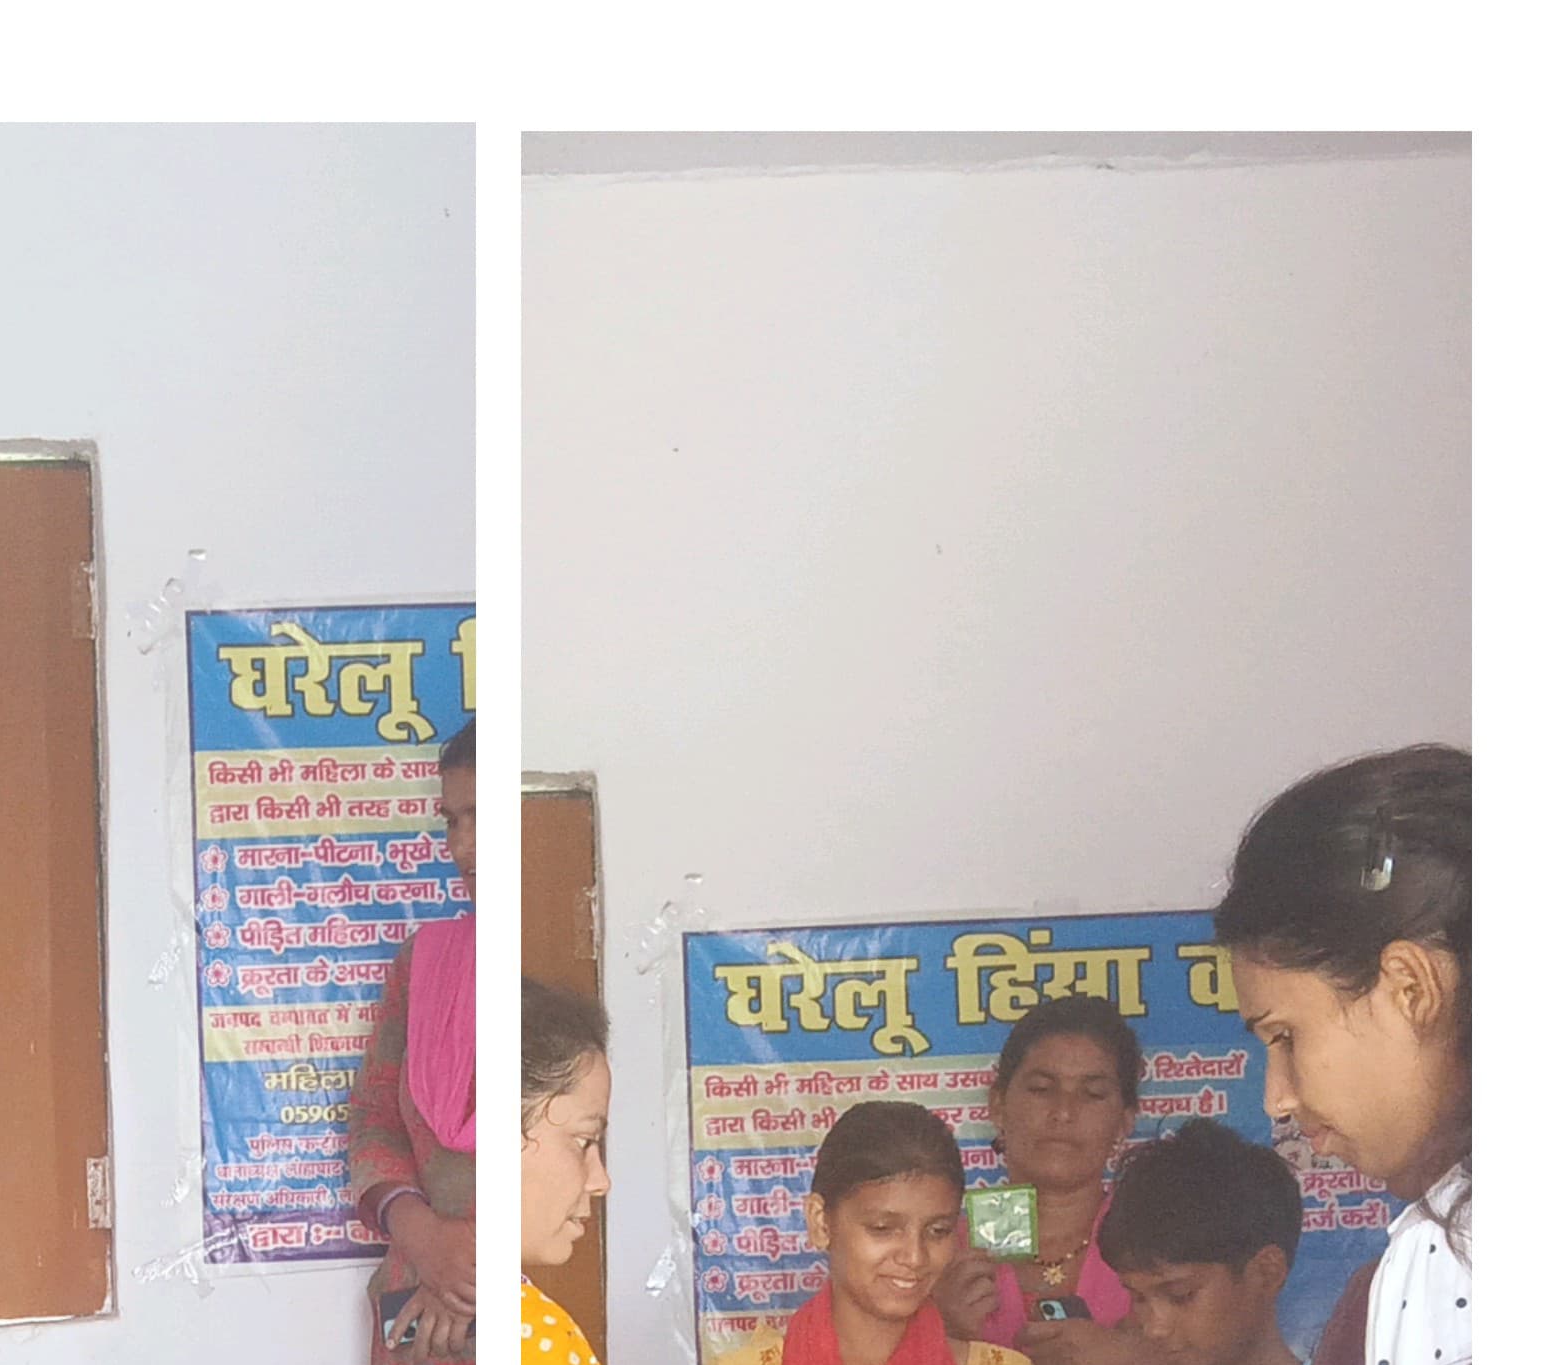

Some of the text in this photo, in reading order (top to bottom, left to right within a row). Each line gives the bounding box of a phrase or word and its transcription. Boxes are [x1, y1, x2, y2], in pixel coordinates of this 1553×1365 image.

[218, 621, 437, 744] घरेलू
[208, 760, 262, 785] किसी
[269, 759, 294, 783] भी
[300, 758, 366, 783] महिला
[373, 757, 395, 779] के
[209, 795, 426, 824] द्वारा किसी भी तरह का
[389, 836, 432, 870] भूखे
[239, 915, 405, 952] पीड़ित महिला या
[714, 941, 932, 1057] घरेलू
[263, 1064, 355, 1092] महिला
[705, 1075, 757, 1099] किसी
[795, 1071, 861, 1096] महिला
